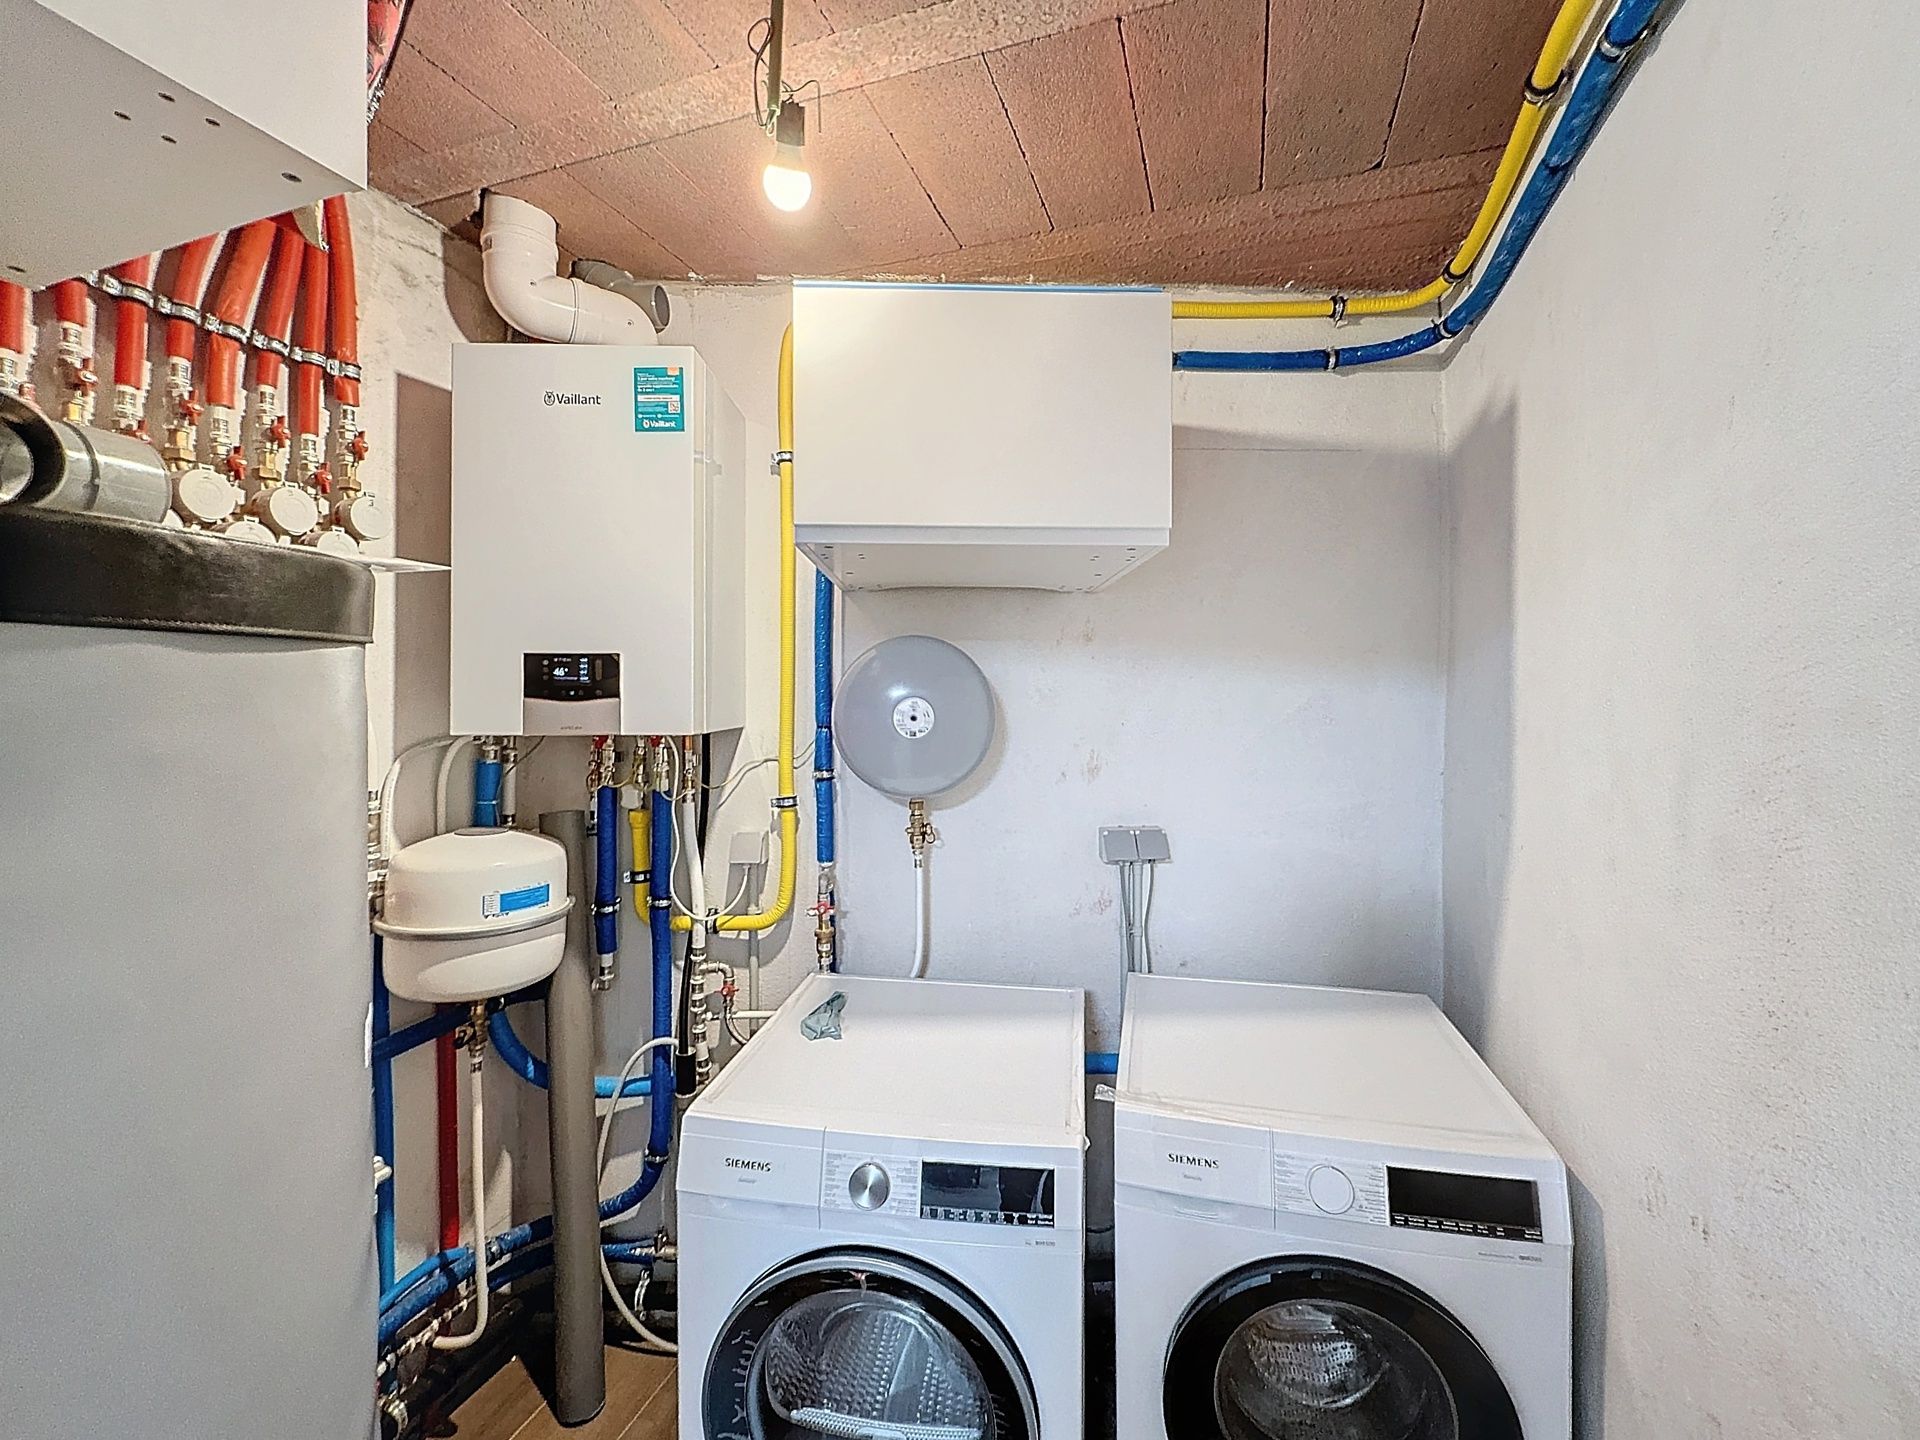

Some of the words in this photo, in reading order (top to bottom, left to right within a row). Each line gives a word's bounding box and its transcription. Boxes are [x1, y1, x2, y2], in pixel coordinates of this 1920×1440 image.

[556, 393, 601, 405] Vaillant
[650, 420, 676, 428] Vaillant
[725, 1157, 772, 1172] SIEMENS
[1168, 1153, 1220, 1169] SIEMENS
